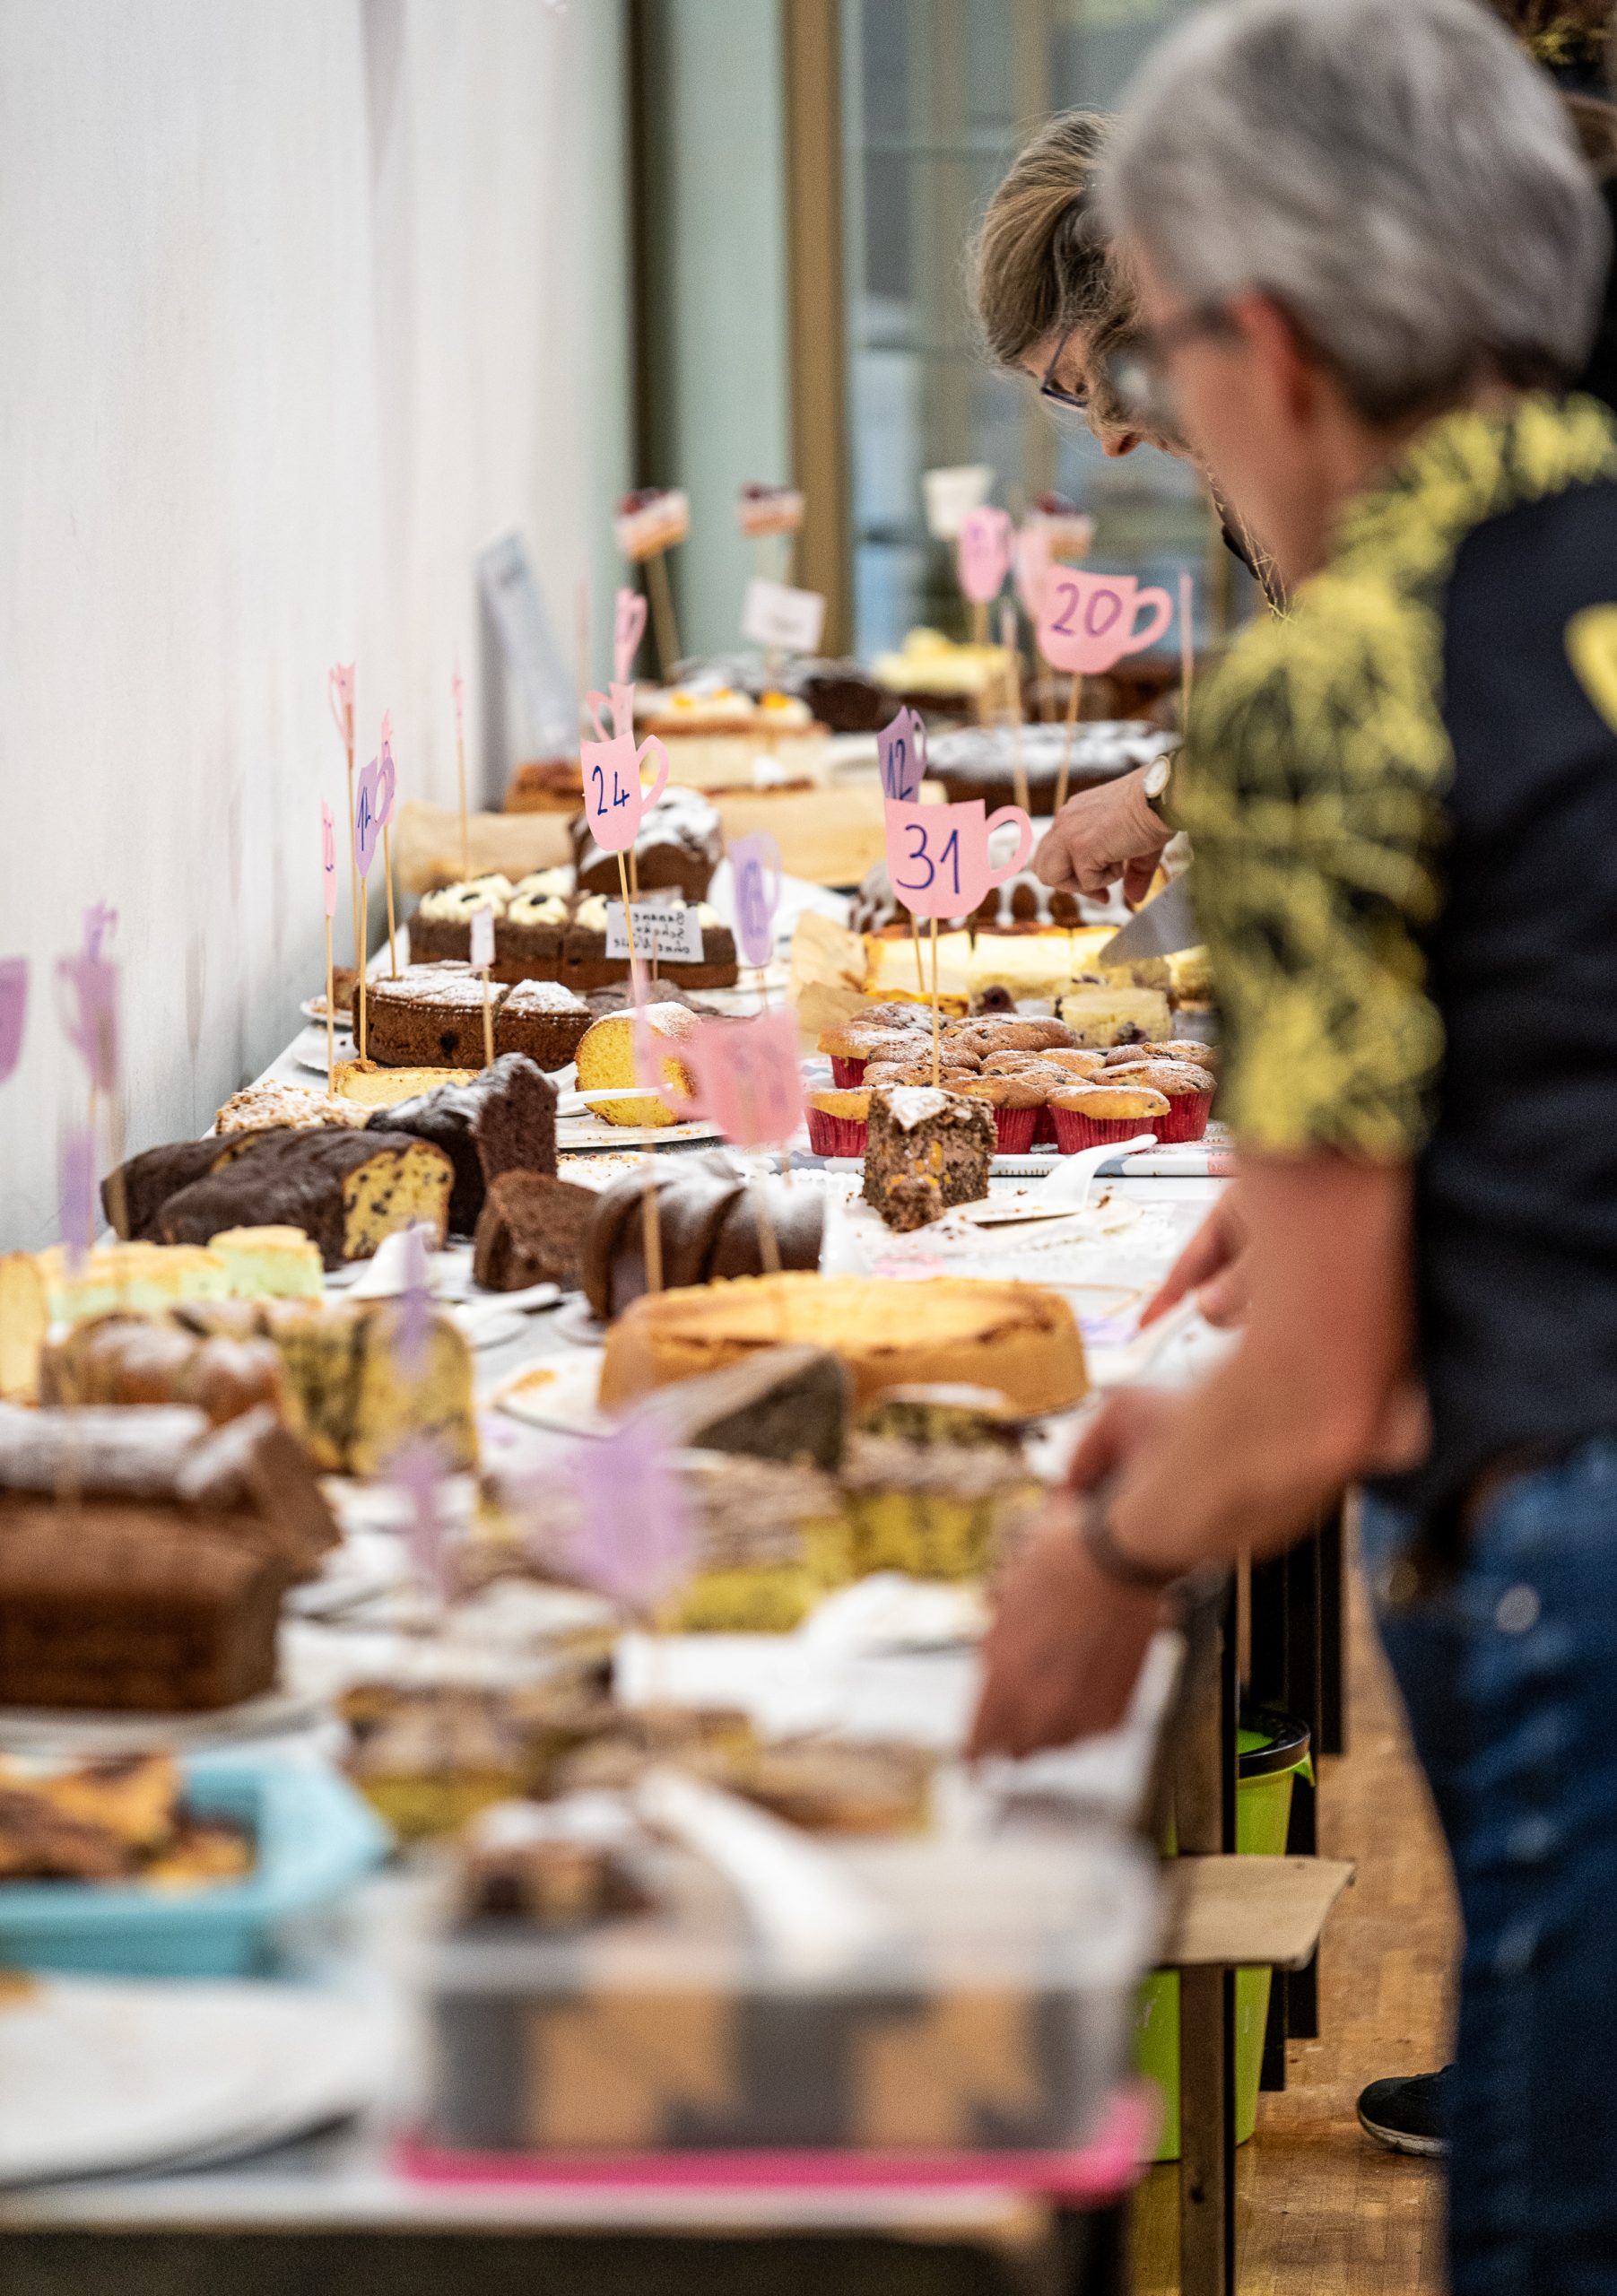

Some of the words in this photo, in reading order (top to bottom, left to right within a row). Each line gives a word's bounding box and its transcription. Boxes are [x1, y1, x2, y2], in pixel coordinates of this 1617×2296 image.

[1051, 582, 1123, 639] 20
[591, 765, 630, 816] 24
[887, 738, 914, 801] 12
[896, 823, 961, 895] 31
